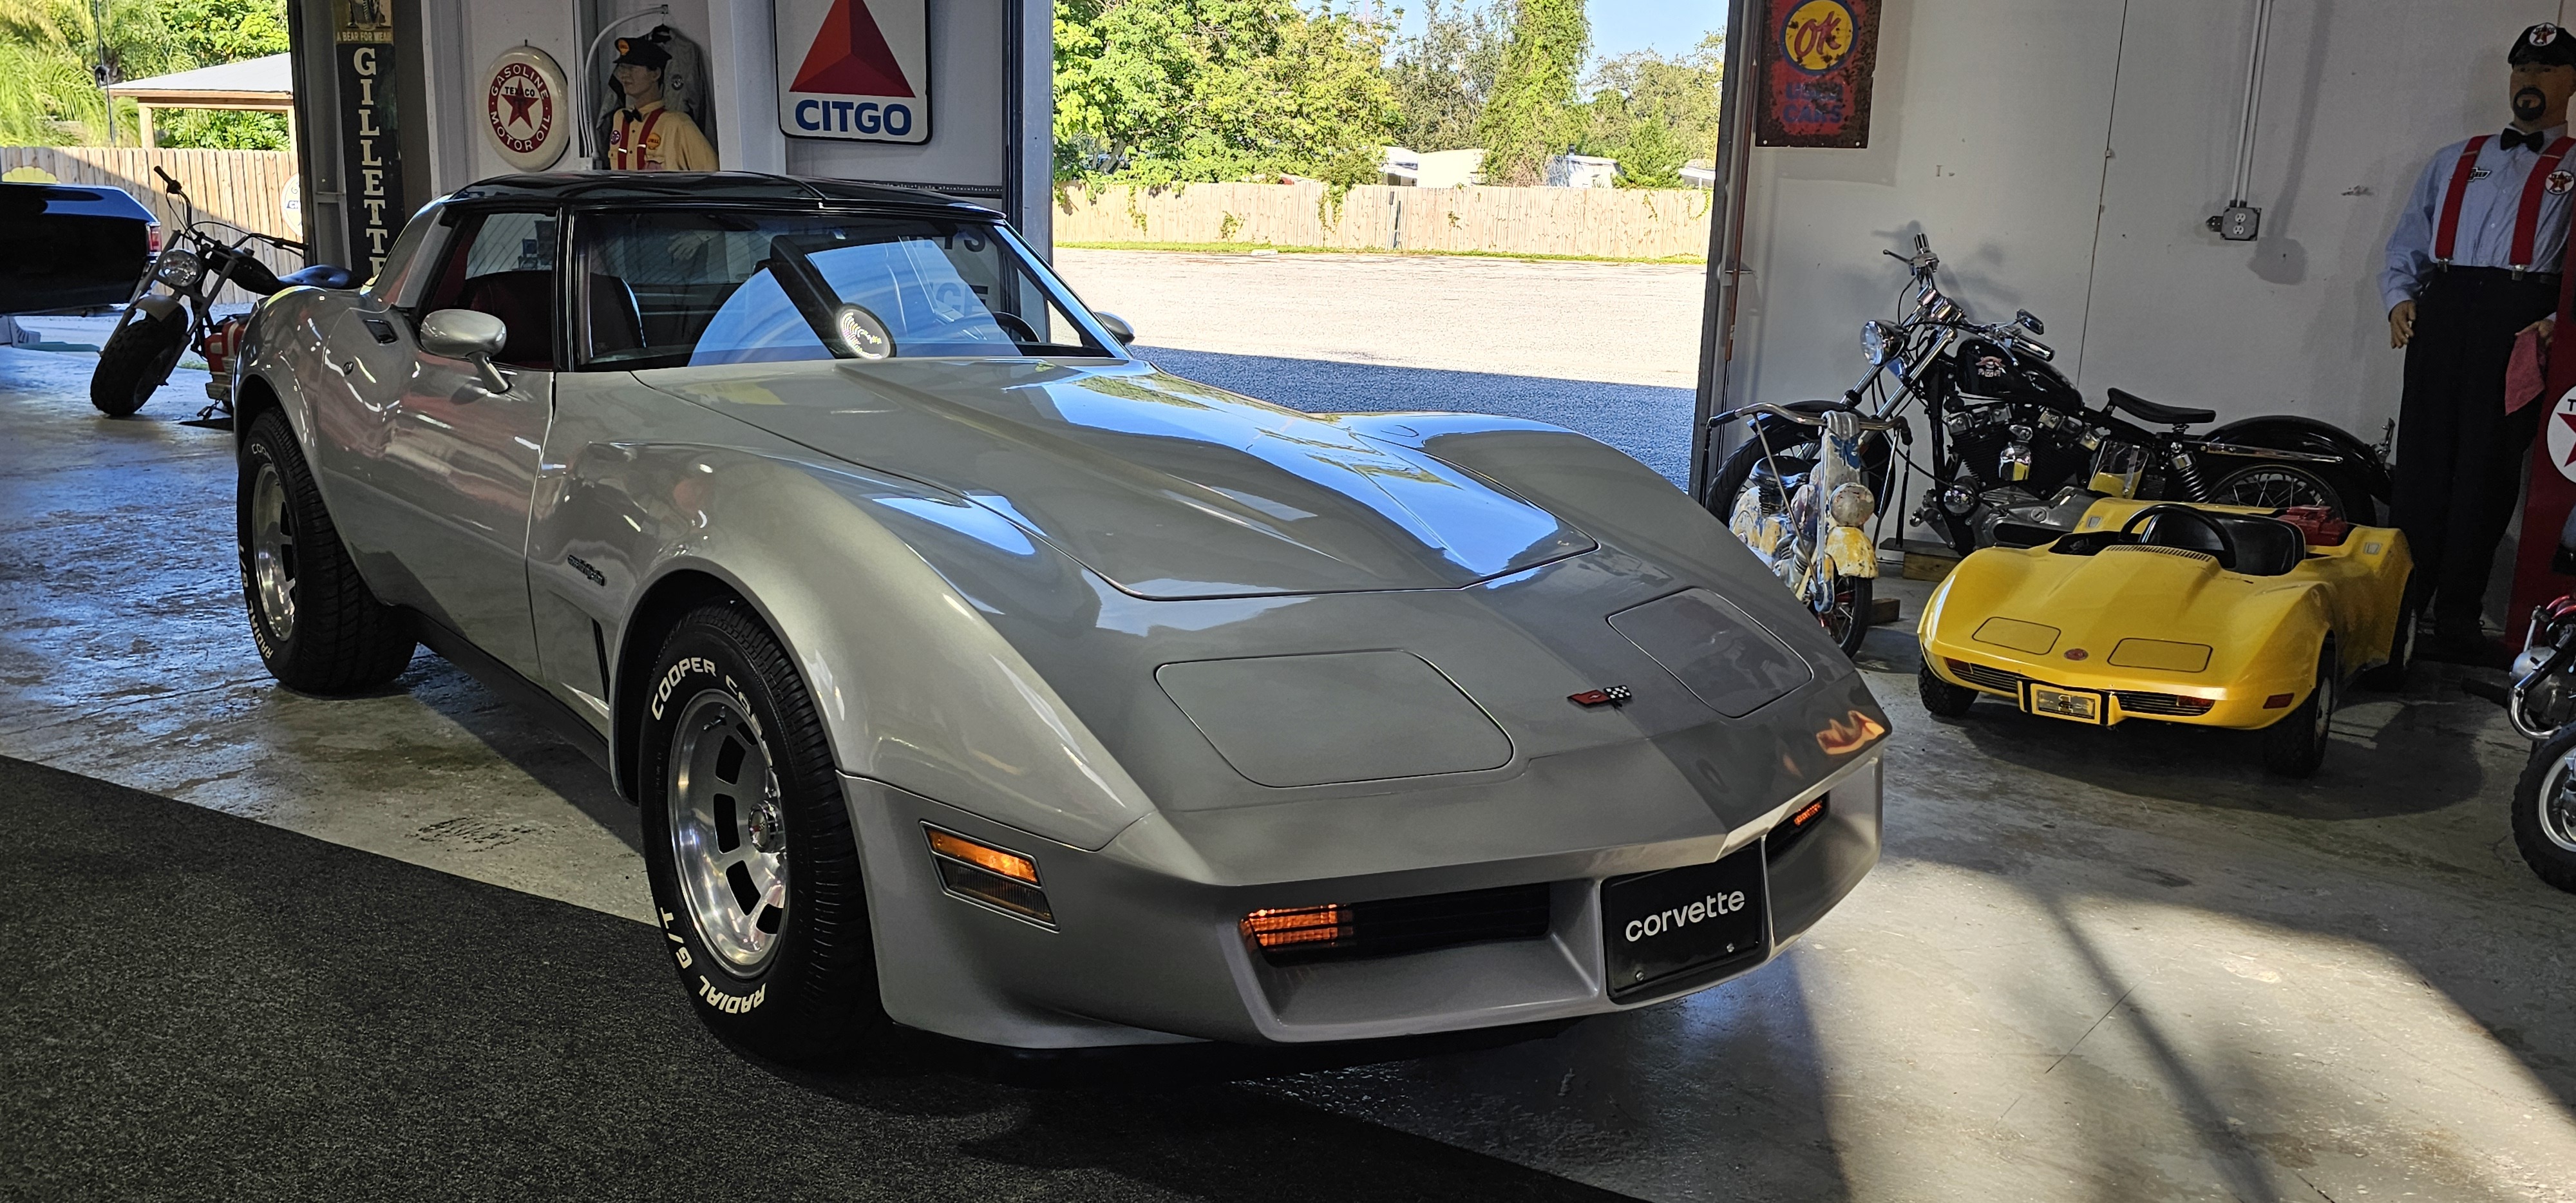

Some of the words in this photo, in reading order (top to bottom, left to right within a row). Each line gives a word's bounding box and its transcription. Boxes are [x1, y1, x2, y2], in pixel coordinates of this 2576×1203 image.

[337, 32, 341, 41] A
[343, 32, 359, 41] BEAR
[361, 32, 372, 41] FOR
[374, 32, 392, 41] WEAR
[1794, 11, 1842, 57] OK
[491, 64, 548, 100] GASOLINE
[505, 86, 535, 97] TEXCO
[490, 111, 533, 151] MOTOR
[536, 115, 550, 141] OIL
[795, 99, 912, 136] CITGO
[652, 657, 717, 721] COOPER
[1625, 891, 1745, 942] corvette
[660, 907, 692, 969] G/T
[699, 974, 766, 1014] RADIAL
